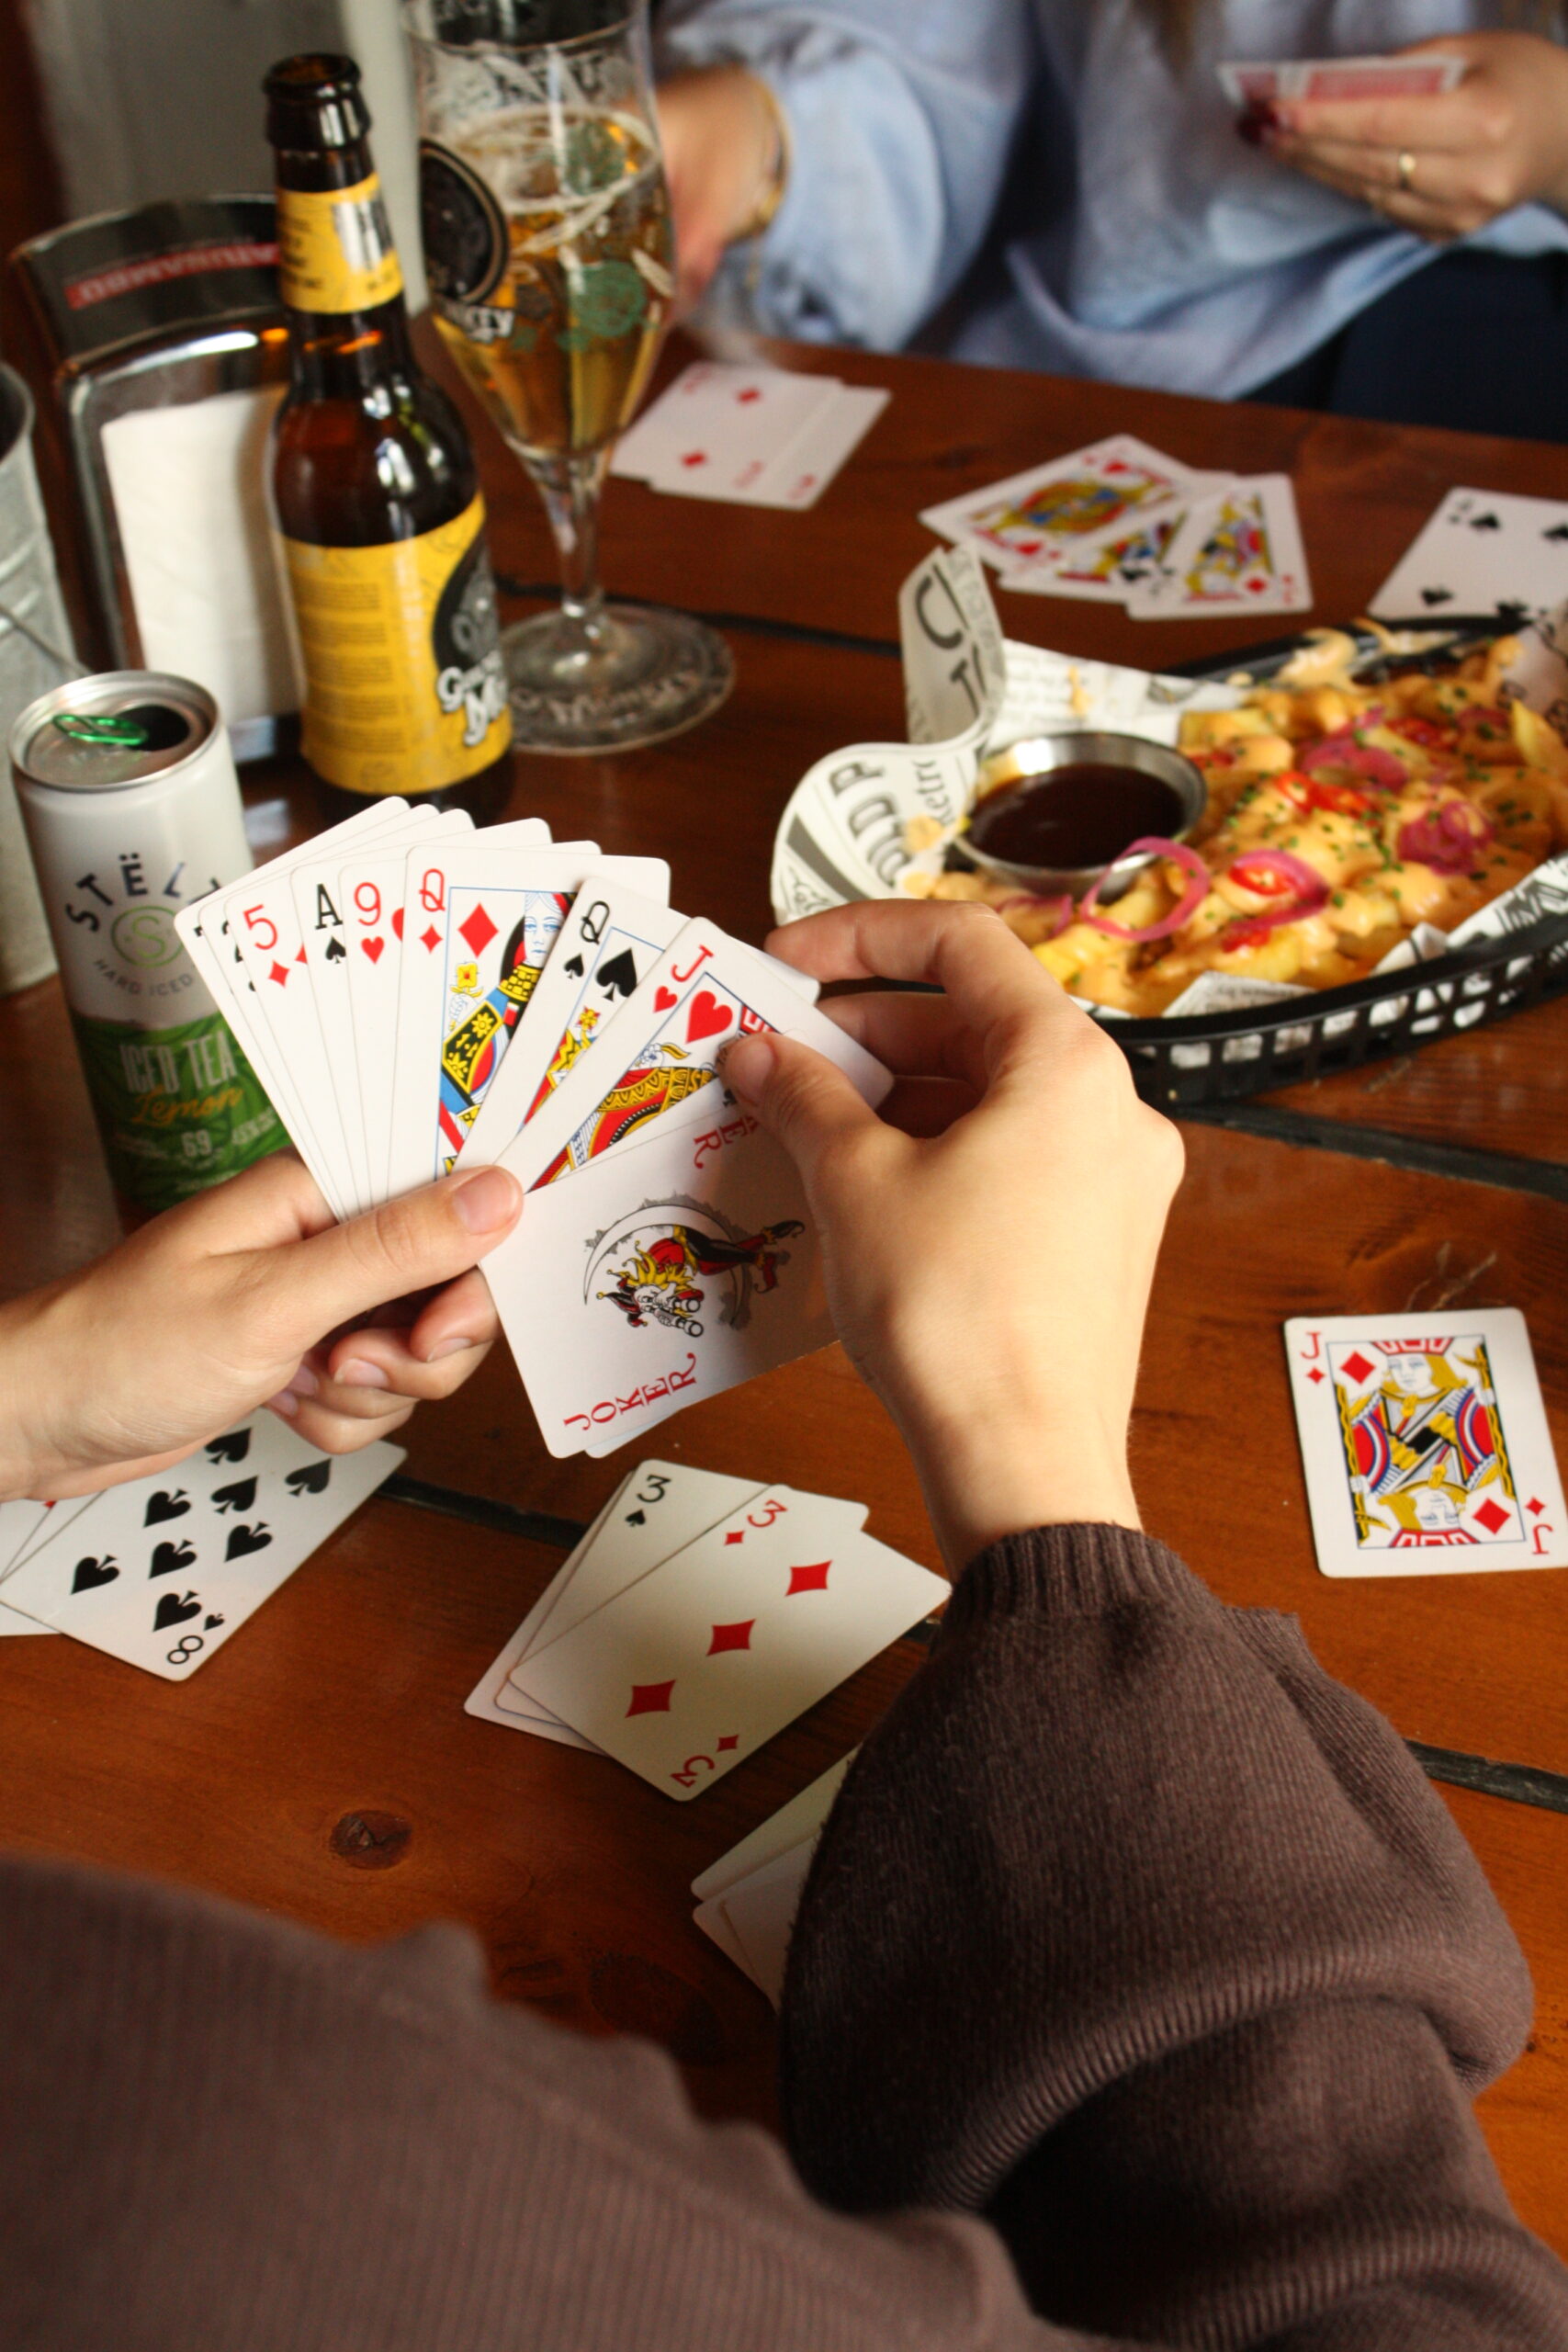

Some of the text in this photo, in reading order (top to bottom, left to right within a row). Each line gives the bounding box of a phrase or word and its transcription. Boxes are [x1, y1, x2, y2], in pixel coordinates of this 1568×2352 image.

[315, 883, 344, 931] A
[353, 881, 382, 926] 9
[419, 868, 446, 912] Q
[243, 903, 278, 951] 5
[580, 900, 610, 945] Q
[671, 944, 715, 983] J
[183, 1029, 238, 1090] TEA
[1301, 1331, 1321, 1360] J
[563, 1352, 696, 1430] JOKER
[637, 1475, 671, 1504] 3
[747, 1499, 787, 1529] 3
[1532, 1523, 1554, 1555] J
[166, 1635, 204, 1665] 8
[671, 1755, 715, 1787] 3
